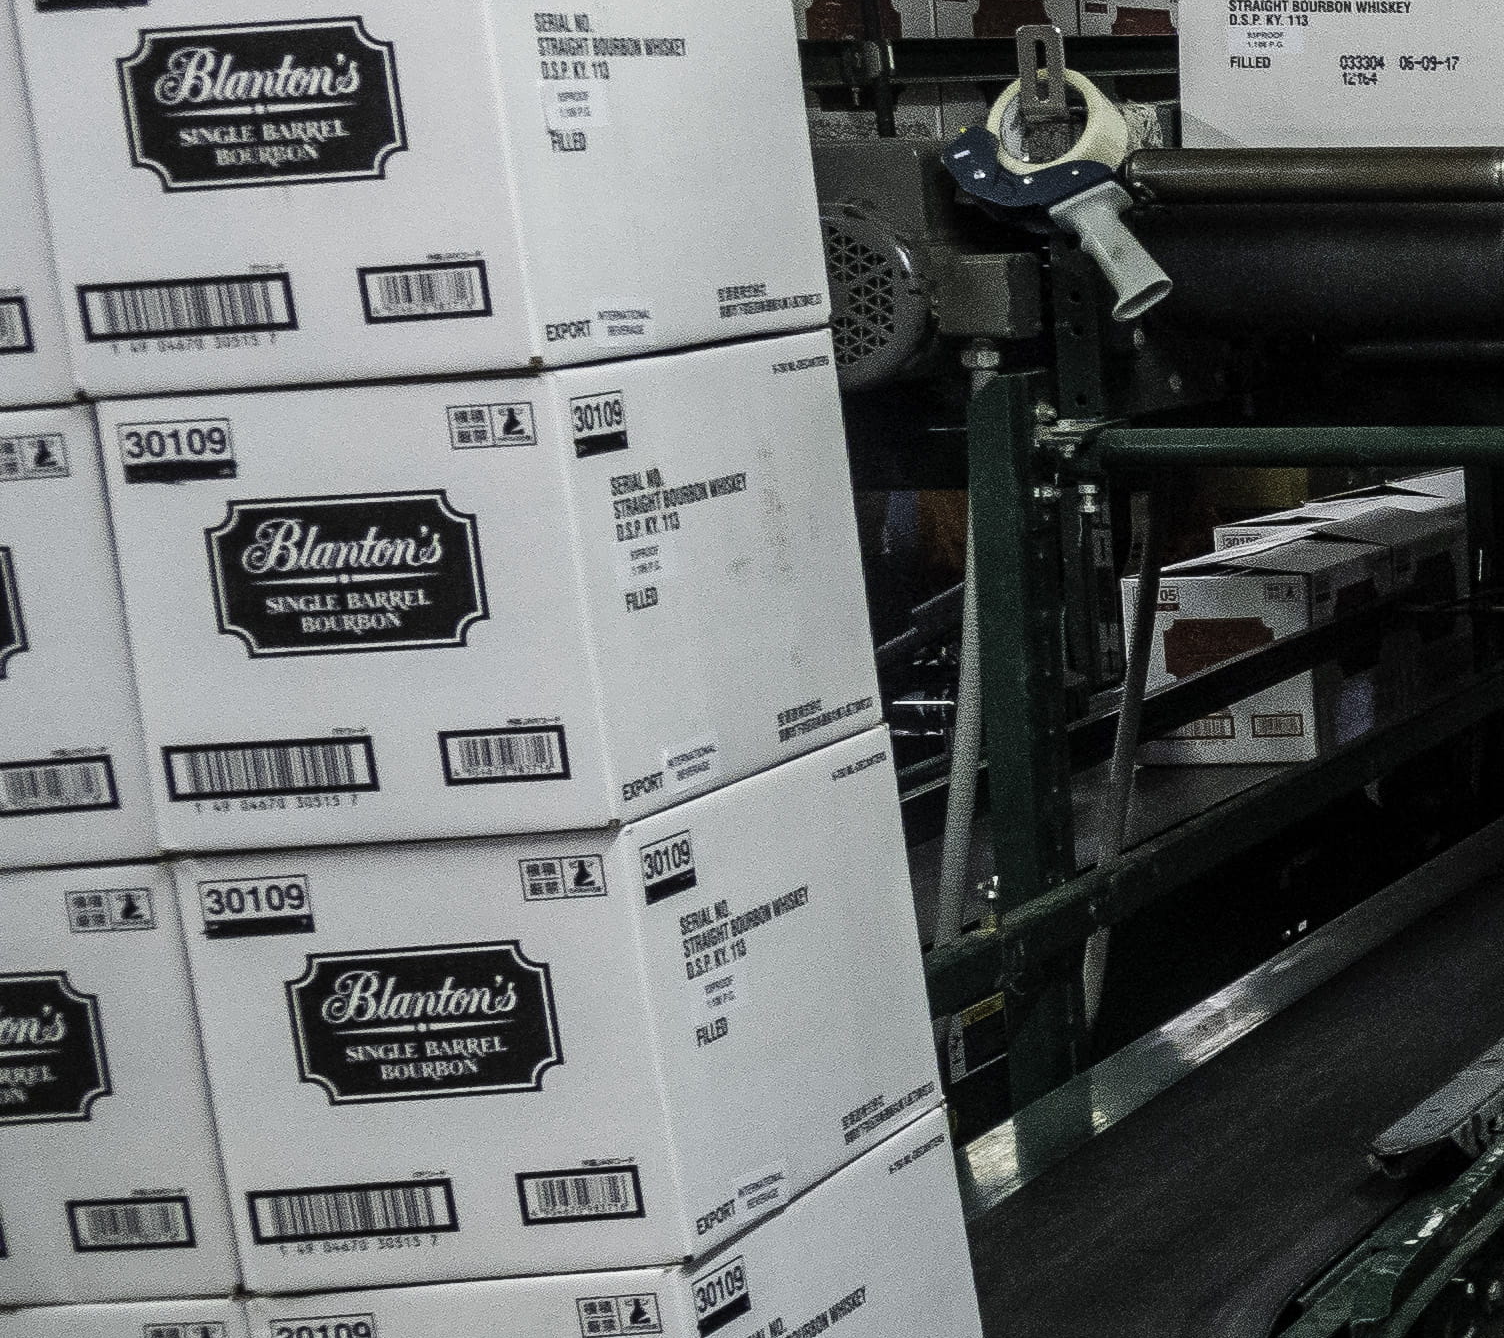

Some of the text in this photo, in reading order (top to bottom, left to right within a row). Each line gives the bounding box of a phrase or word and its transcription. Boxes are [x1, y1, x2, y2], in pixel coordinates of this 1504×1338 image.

[1229, 0, 1411, 15] STRAIGHT BOURBON WHISKEY
[1229, 13, 1309, 28] D.S.P. KY. 113
[153, 46, 363, 107] Blanton's
[1230, 56, 1271, 70] FILLED
[1339, 55, 1461, 72] 033304 06-09-17
[178, 117, 350, 147] SINGLE BARREL
[215, 143, 321, 168] BOURBON
[545, 319, 591, 342] EXPORT
[124, 425, 229, 459] 30109
[241, 518, 444, 576] Blanton's
[264, 587, 431, 616] SINGLE BARREL
[300, 610, 402, 636] BOURBON
[321, 968, 517, 1026] Blanton's
[345, 1034, 508, 1063] SINGLE BARREL
[379, 1057, 480, 1081] BOURBON
[695, 1265, 745, 1314] 30109
